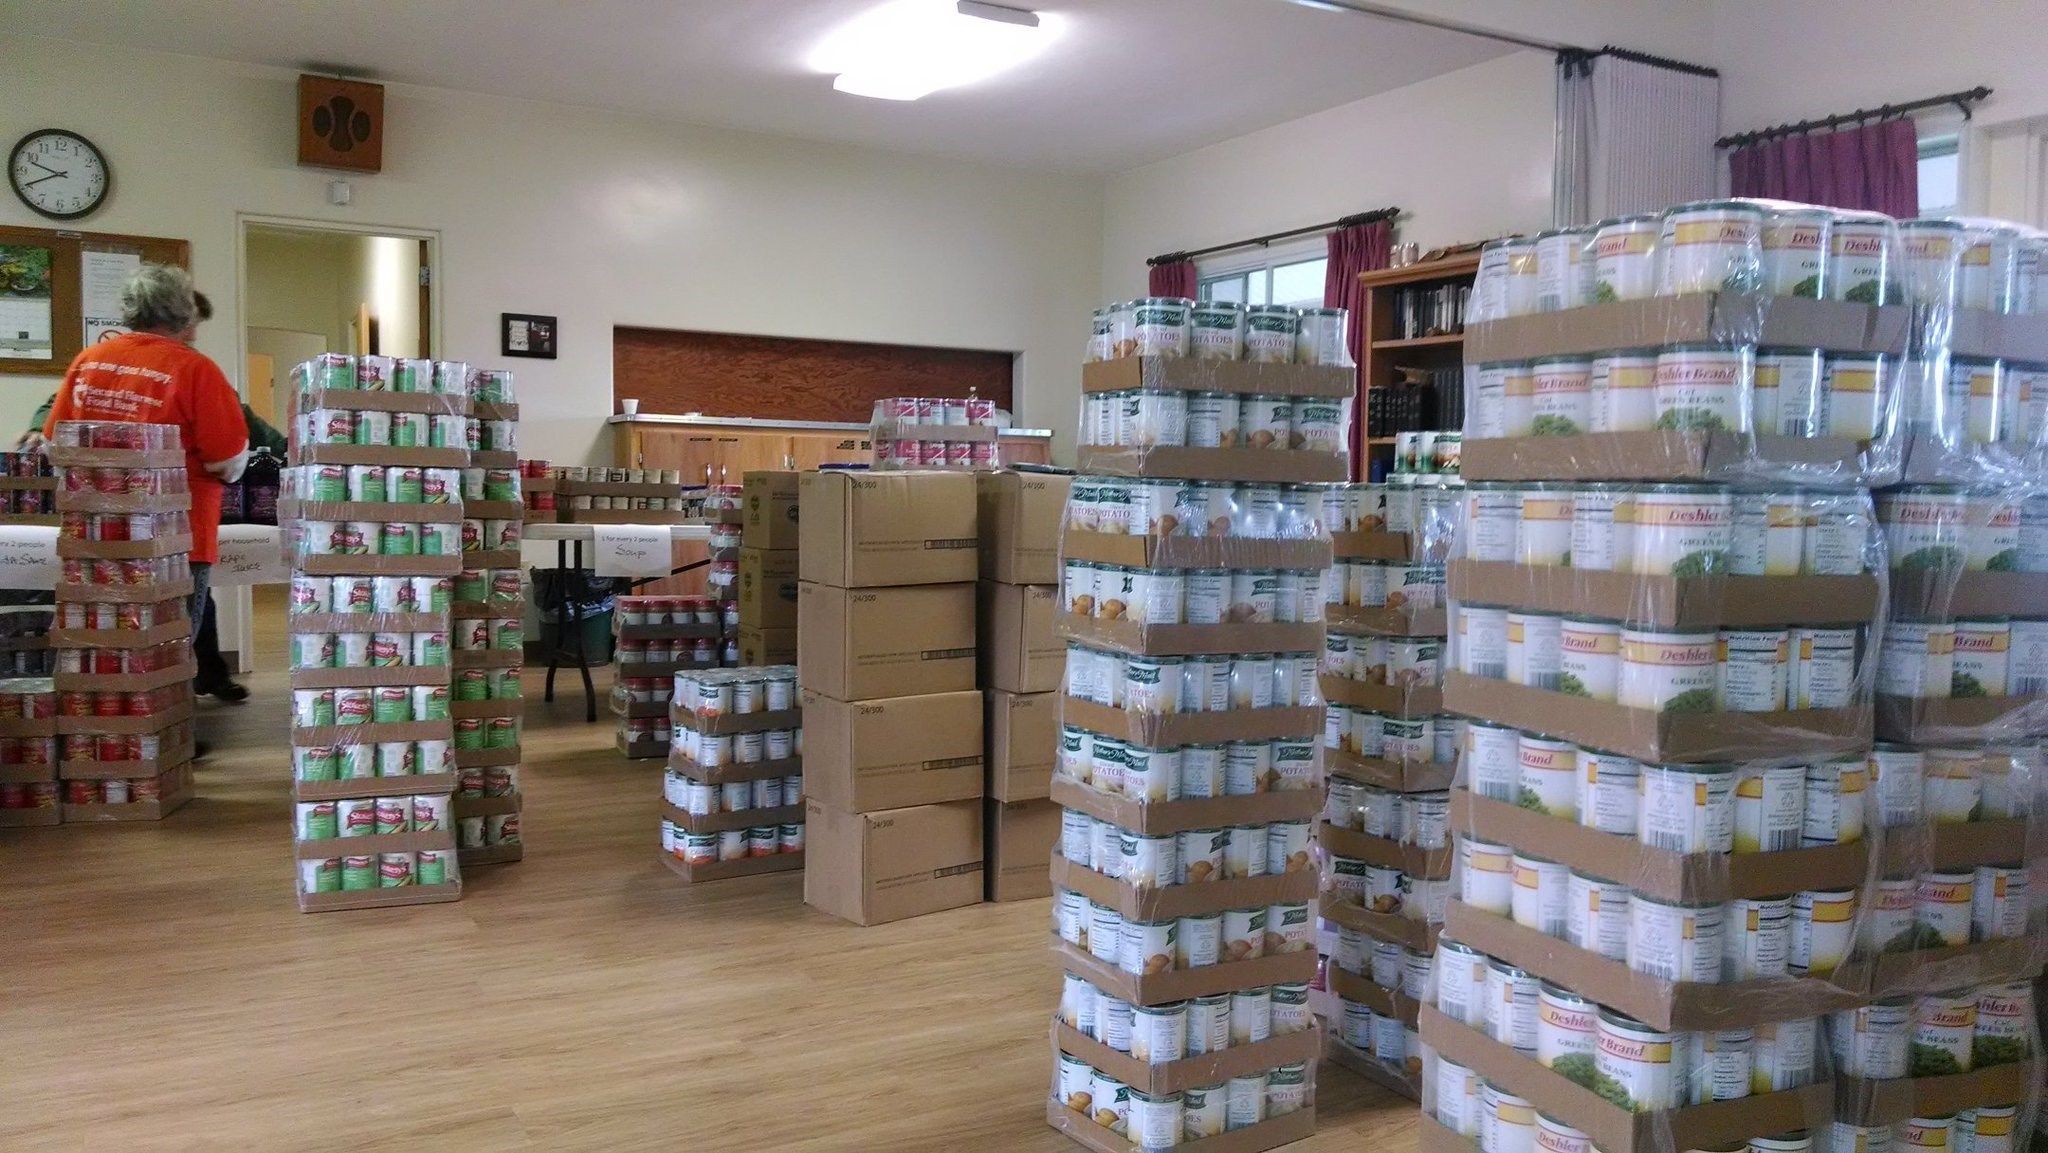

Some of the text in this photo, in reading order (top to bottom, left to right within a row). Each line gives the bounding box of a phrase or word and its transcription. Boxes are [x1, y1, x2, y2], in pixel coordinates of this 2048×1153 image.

[39, 142, 49, 154] 11
[55, 140, 67, 151] 12
[27, 151, 39, 162] 10
[85, 158, 93, 168] 2
[1563, 634, 1598, 649] Brand
[1953, 637, 1995, 649] Brand
[1521, 750, 1554, 765] Brand
[1550, 1010, 1597, 1029] Deshler
[1606, 1038, 1645, 1057] Brand
